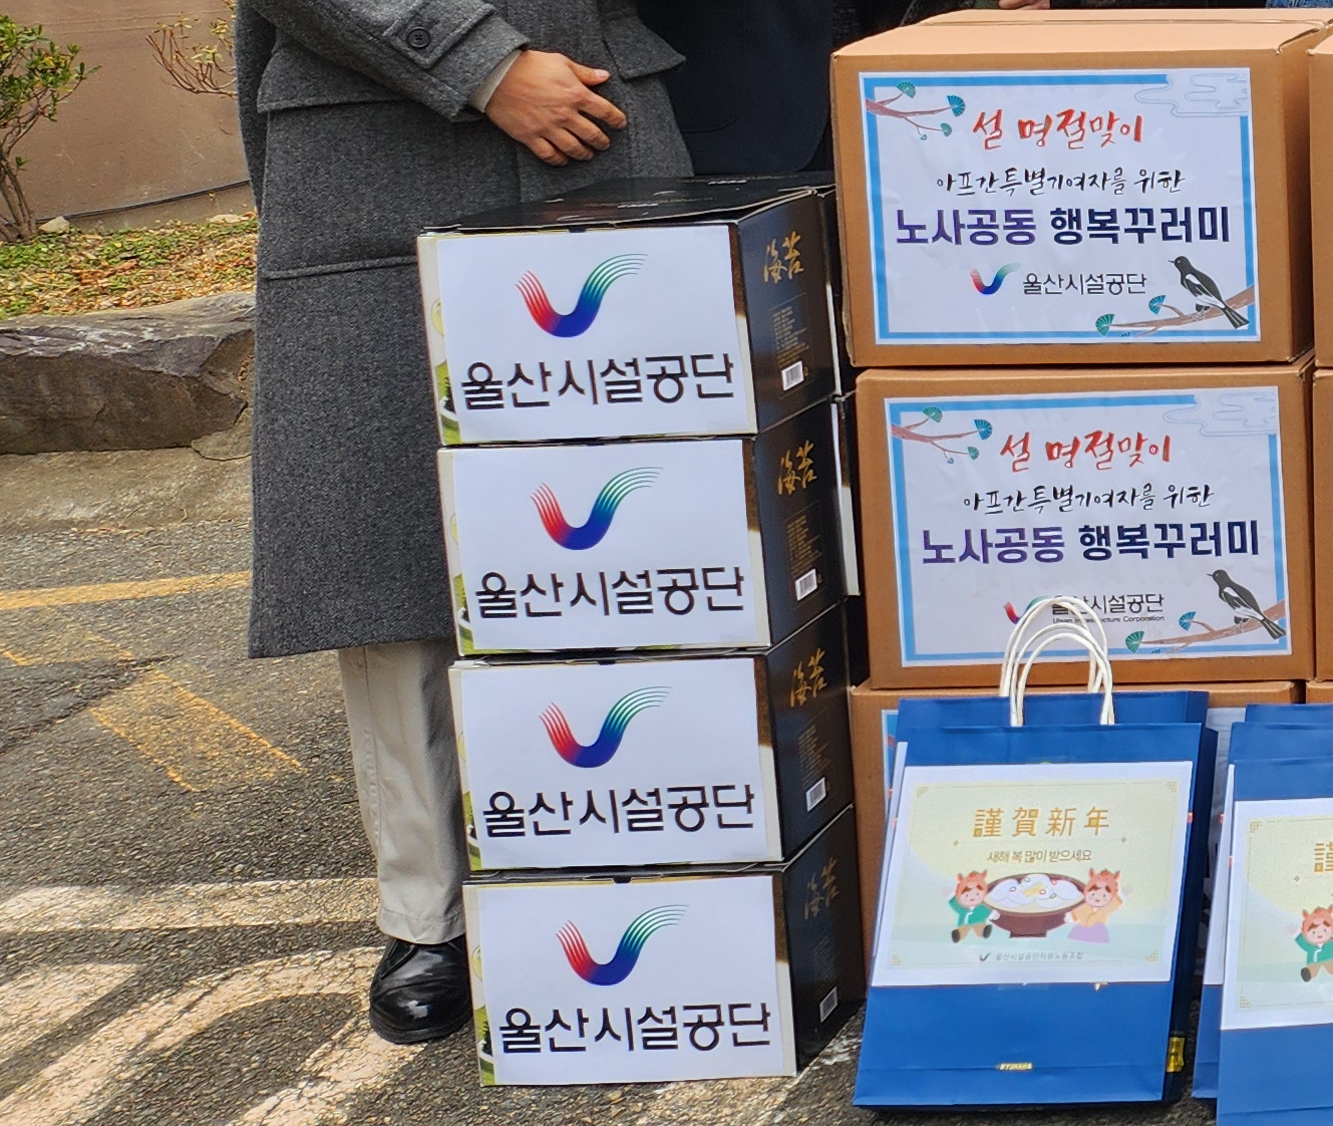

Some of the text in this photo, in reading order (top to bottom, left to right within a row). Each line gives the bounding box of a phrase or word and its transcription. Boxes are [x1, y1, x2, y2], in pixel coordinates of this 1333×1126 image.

[972, 109, 1143, 150] 설 명절맞이
[937, 167, 1185, 197] 아프간특별기여자를 위한
[896, 206, 1230, 245] 노사공동 행복꾸러미
[1022, 273, 1147, 295] 울산시설공단
[461, 352, 734, 410] 울산시설공단
[1000, 430, 1171, 472] 설 명절맞이
[964, 483, 1215, 514] 아프간특별기여자를 위한
[922, 520, 1259, 564] 노사공동 행복꾸러미
[476, 566, 744, 619] 울산시설공단
[483, 784, 755, 838] 울산시설공단
[972, 806, 1109, 839] 謹賀新年
[987, 849, 1092, 863] 새해 복 많이 받으세요
[499, 1002, 771, 1054] 울산시설공단
